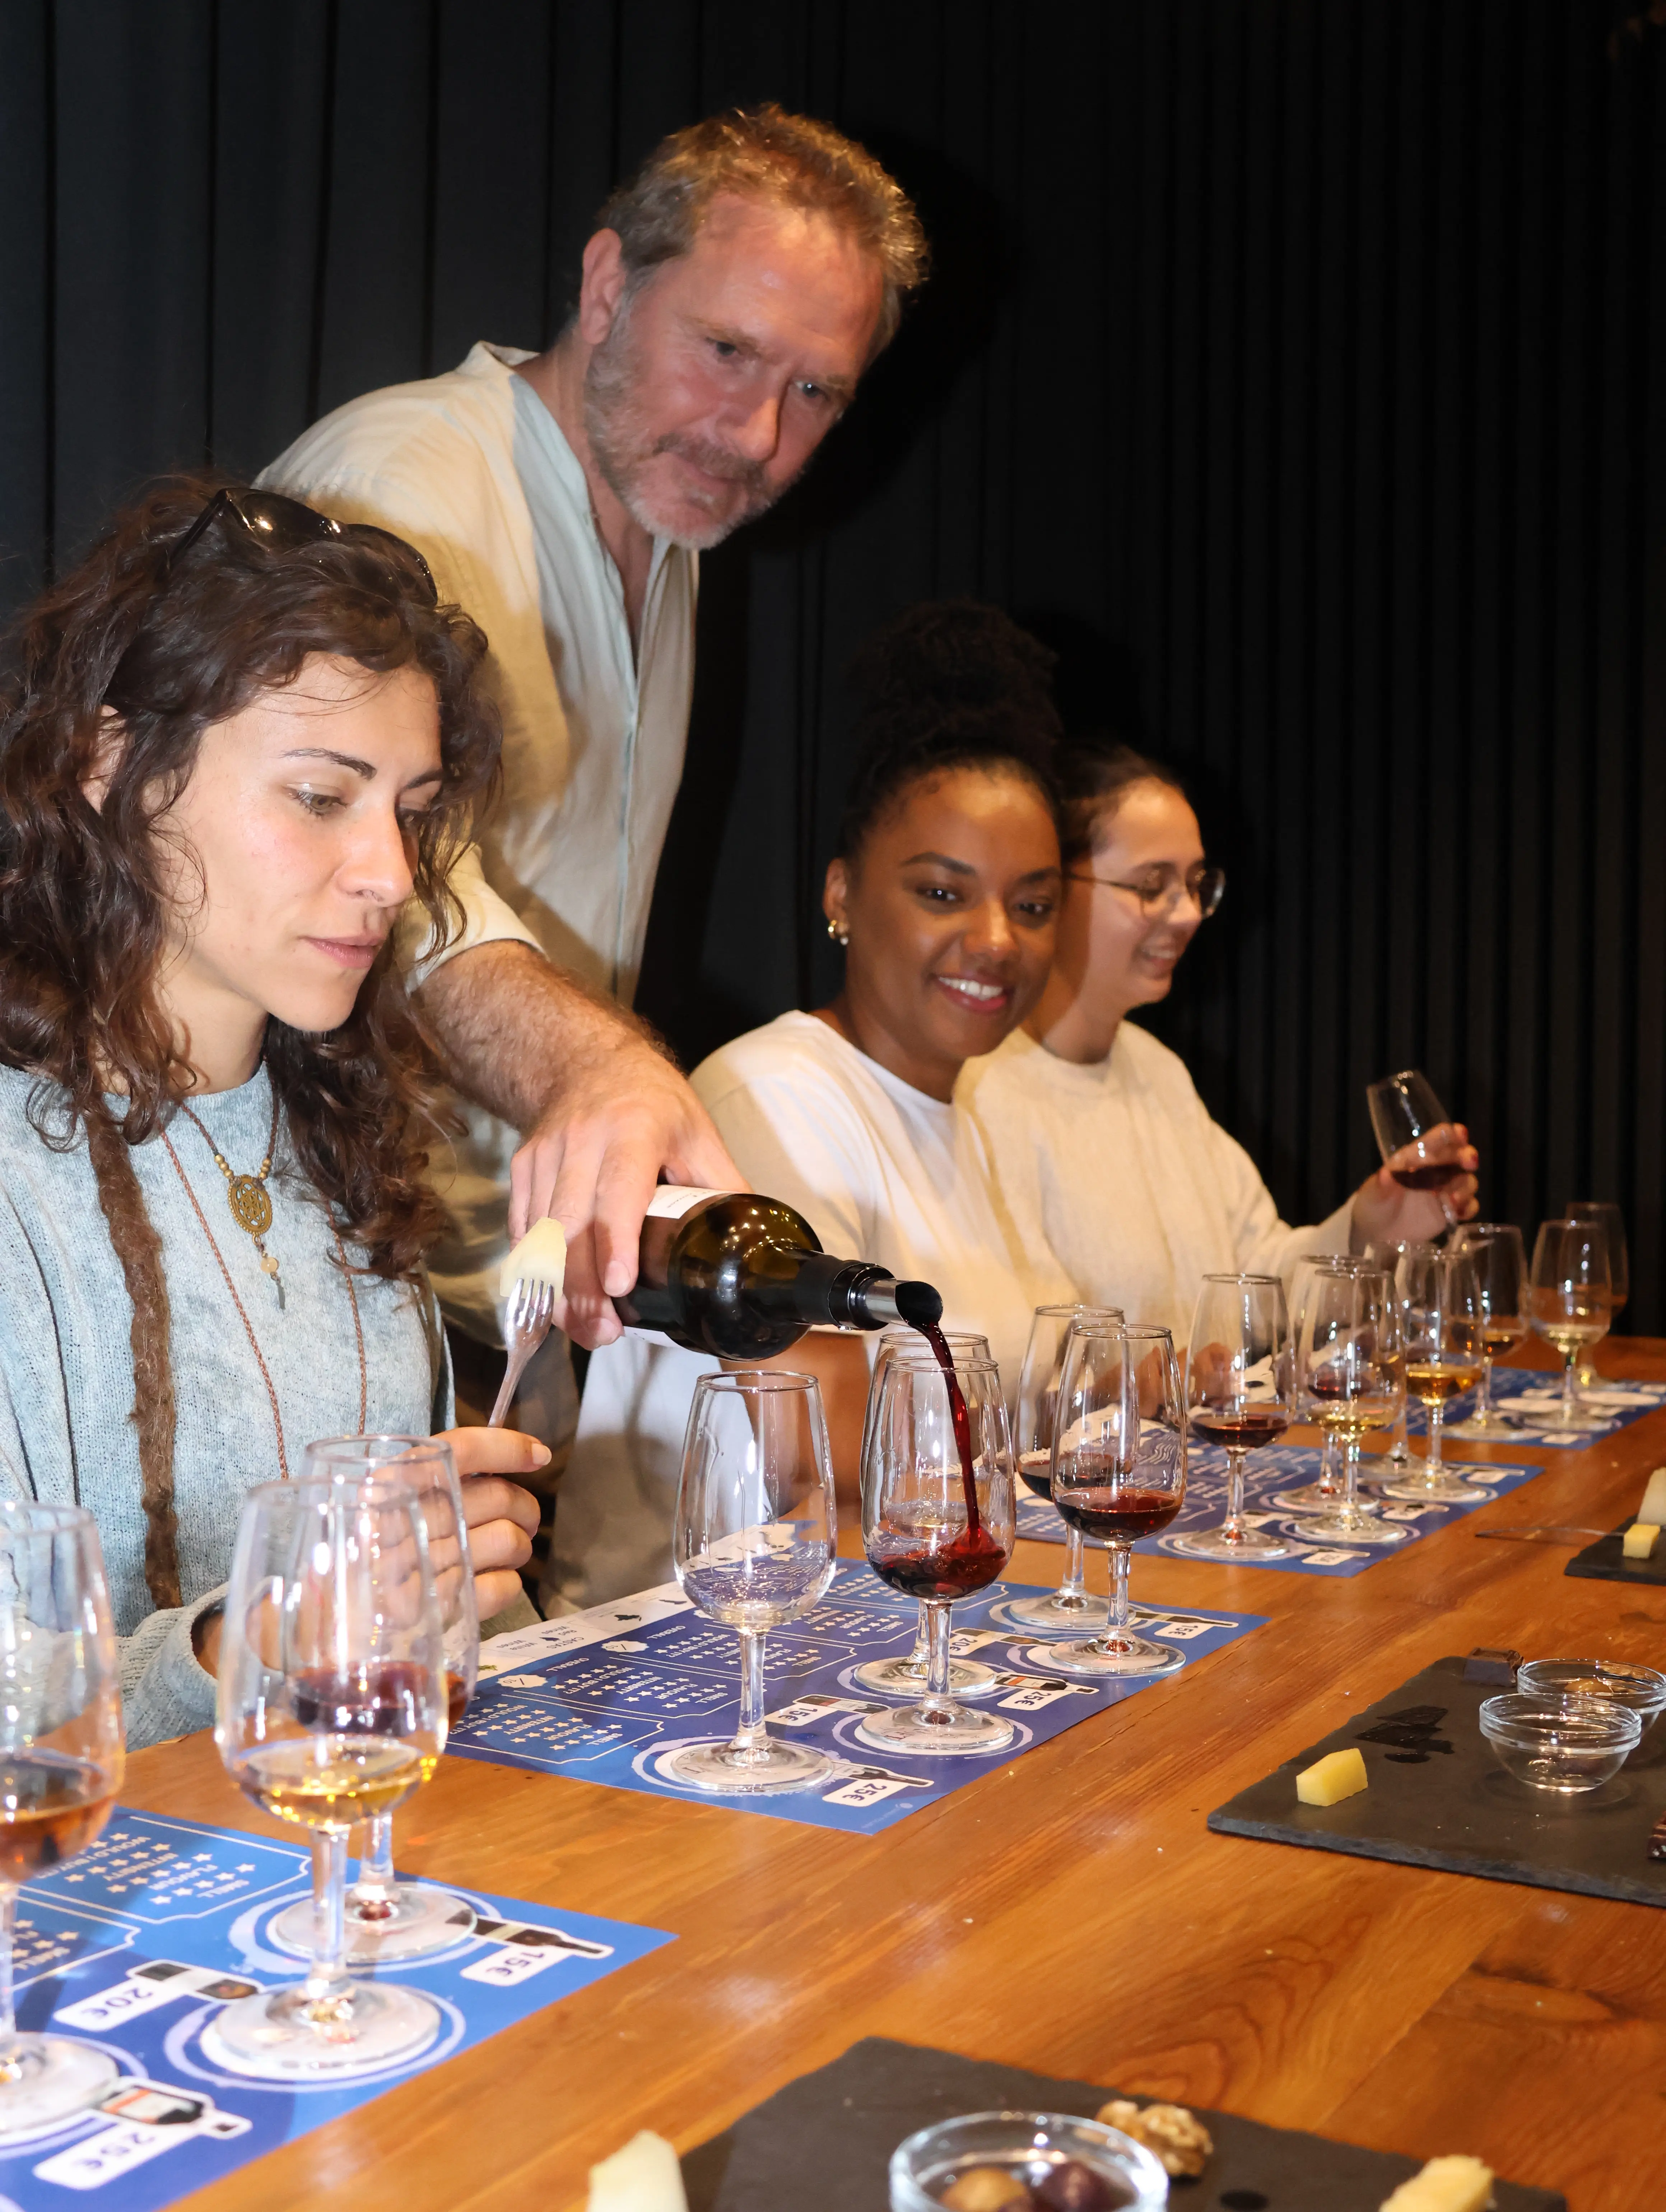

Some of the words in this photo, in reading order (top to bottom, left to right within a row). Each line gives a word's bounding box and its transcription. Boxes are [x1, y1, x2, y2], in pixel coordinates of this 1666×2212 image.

[646, 1626, 686, 1639] OVERALL
[1168, 1624, 1198, 1637] 15€
[546, 1637, 584, 1649] CASTAS
[698, 1634, 731, 1646] WOULD
[949, 1637, 977, 1652] 20€
[546, 1658, 590, 1671] OVERALL
[599, 1667, 635, 1679] WOULD
[577, 1680, 599, 1690] BUY
[616, 1676, 663, 1695] INTENSITY
[654, 1683, 699, 1700] FLAVOUR
[695, 1692, 728, 1704] SMELL
[1014, 1690, 1052, 1706] 25€
[488, 1705, 528, 1719] WOULD
[778, 1707, 818, 1721] 15€
[464, 1719, 487, 1728] BUY
[503, 1715, 556, 1735] INTENSITY
[543, 1724, 592, 1741] FLAVOUR
[586, 1733, 623, 1746] SMELL
[842, 1783, 887, 1801] 25€
[486, 1951, 545, 1976] 15€
[82, 1989, 153, 2019] 20€
